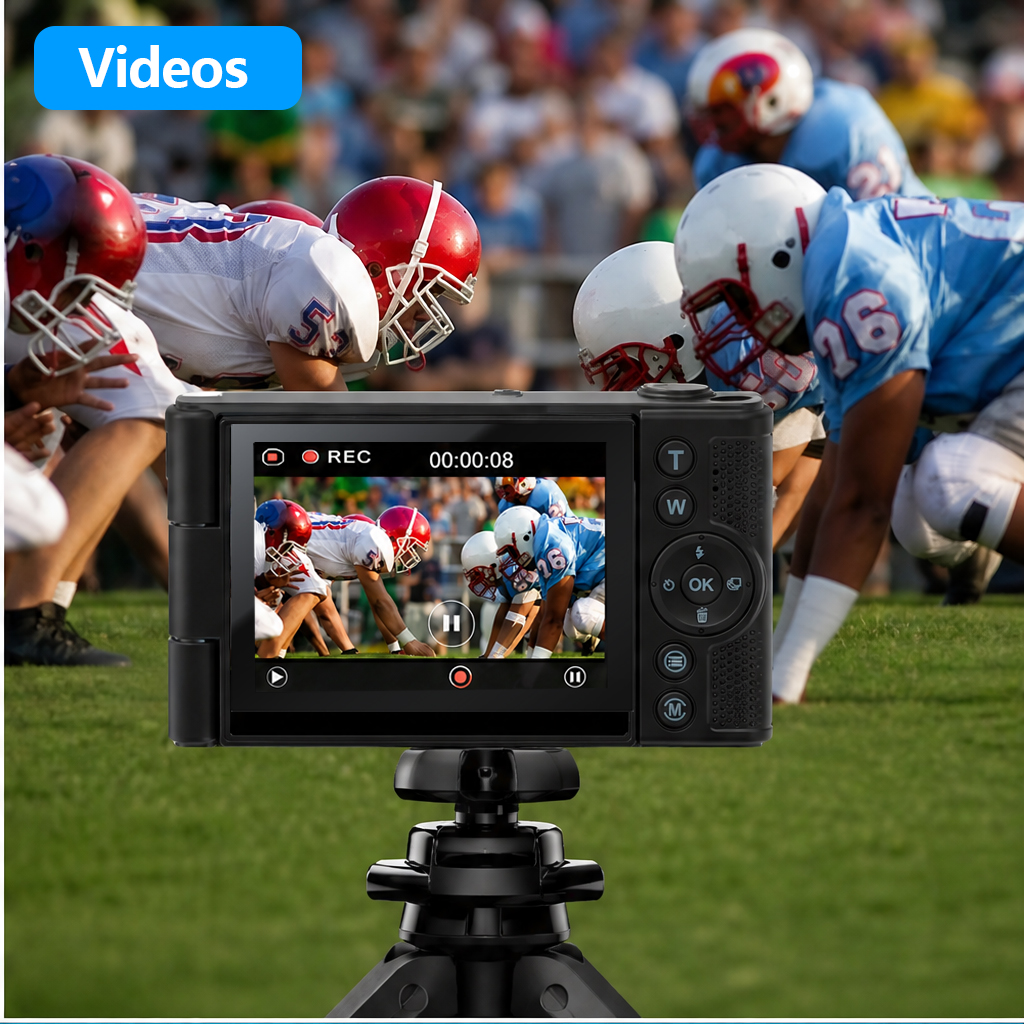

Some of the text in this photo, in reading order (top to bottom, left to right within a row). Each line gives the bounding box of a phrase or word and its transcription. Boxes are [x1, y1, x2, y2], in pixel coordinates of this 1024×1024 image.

[328, 449, 371, 464] REC
[429, 451, 514, 469] 00:00:08
[668, 450, 684, 471] T
[666, 499, 686, 515] W
[688, 577, 714, 592] OK
[668, 702, 682, 717] M
